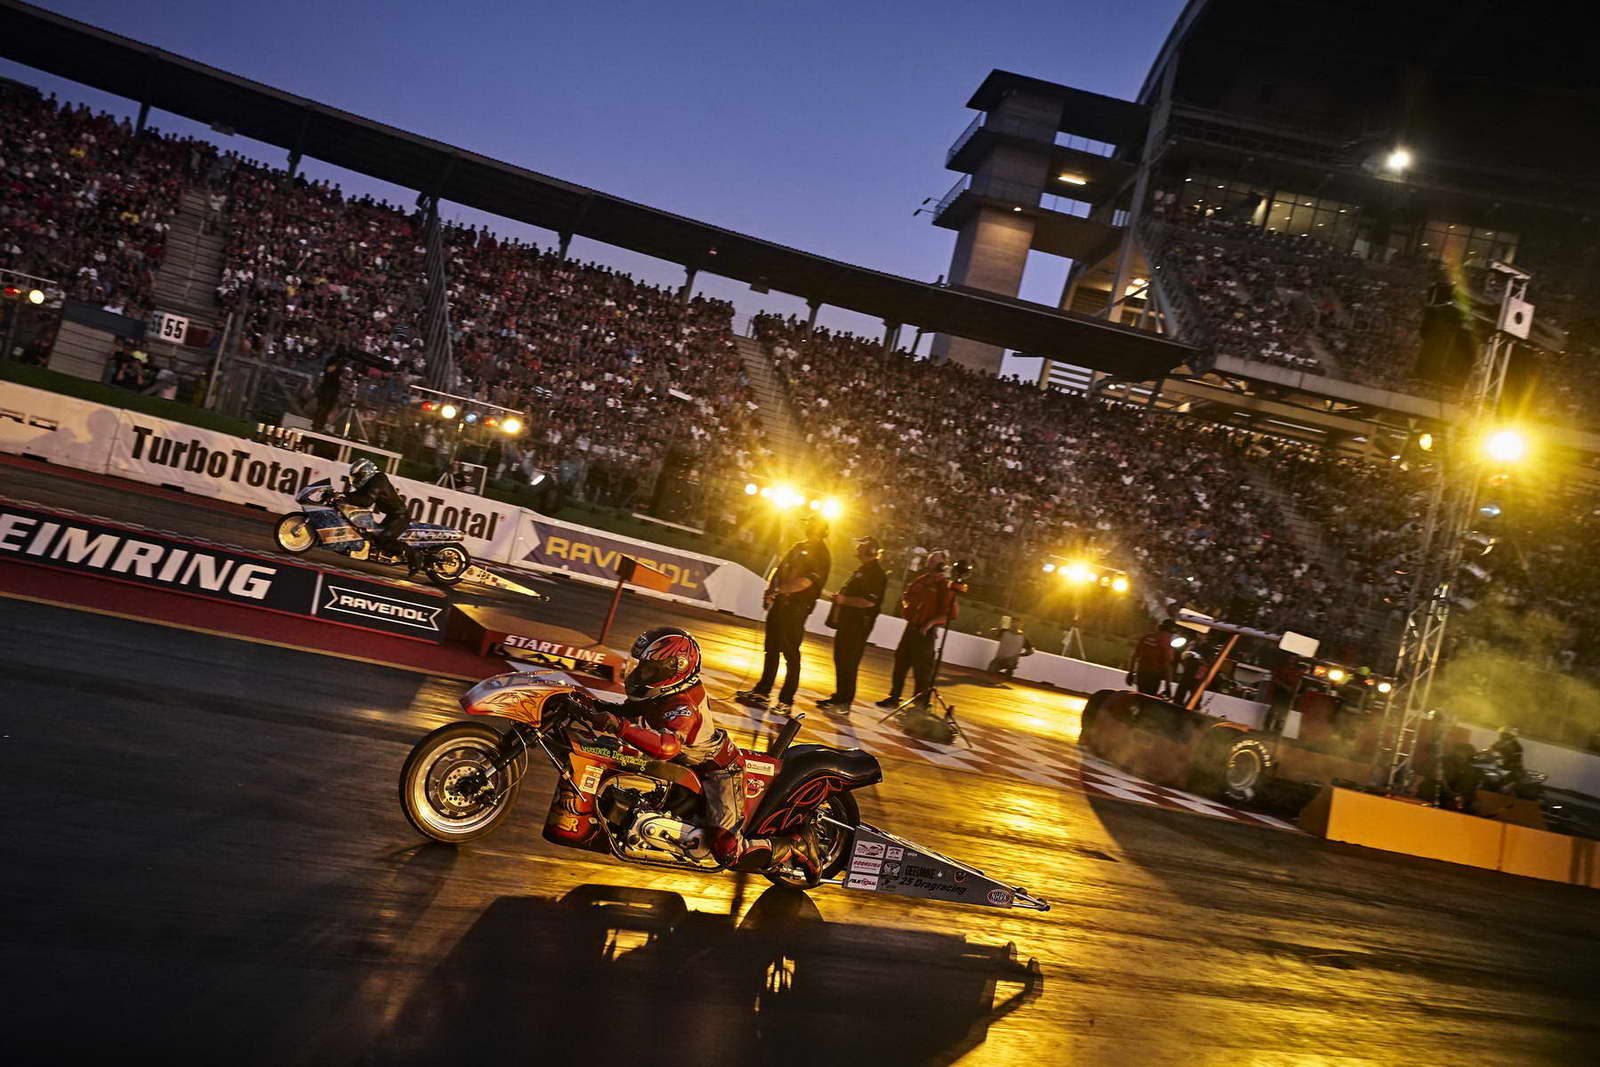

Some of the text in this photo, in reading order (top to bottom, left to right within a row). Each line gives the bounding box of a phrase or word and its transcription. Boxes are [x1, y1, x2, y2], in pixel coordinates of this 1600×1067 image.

[164, 318, 185, 339] 55
[131, 425, 312, 495] TurboTotal
[0, 513, 277, 600] EIMRING
[340, 594, 427, 623] RAVENOL
[503, 634, 607, 664] START LINE
